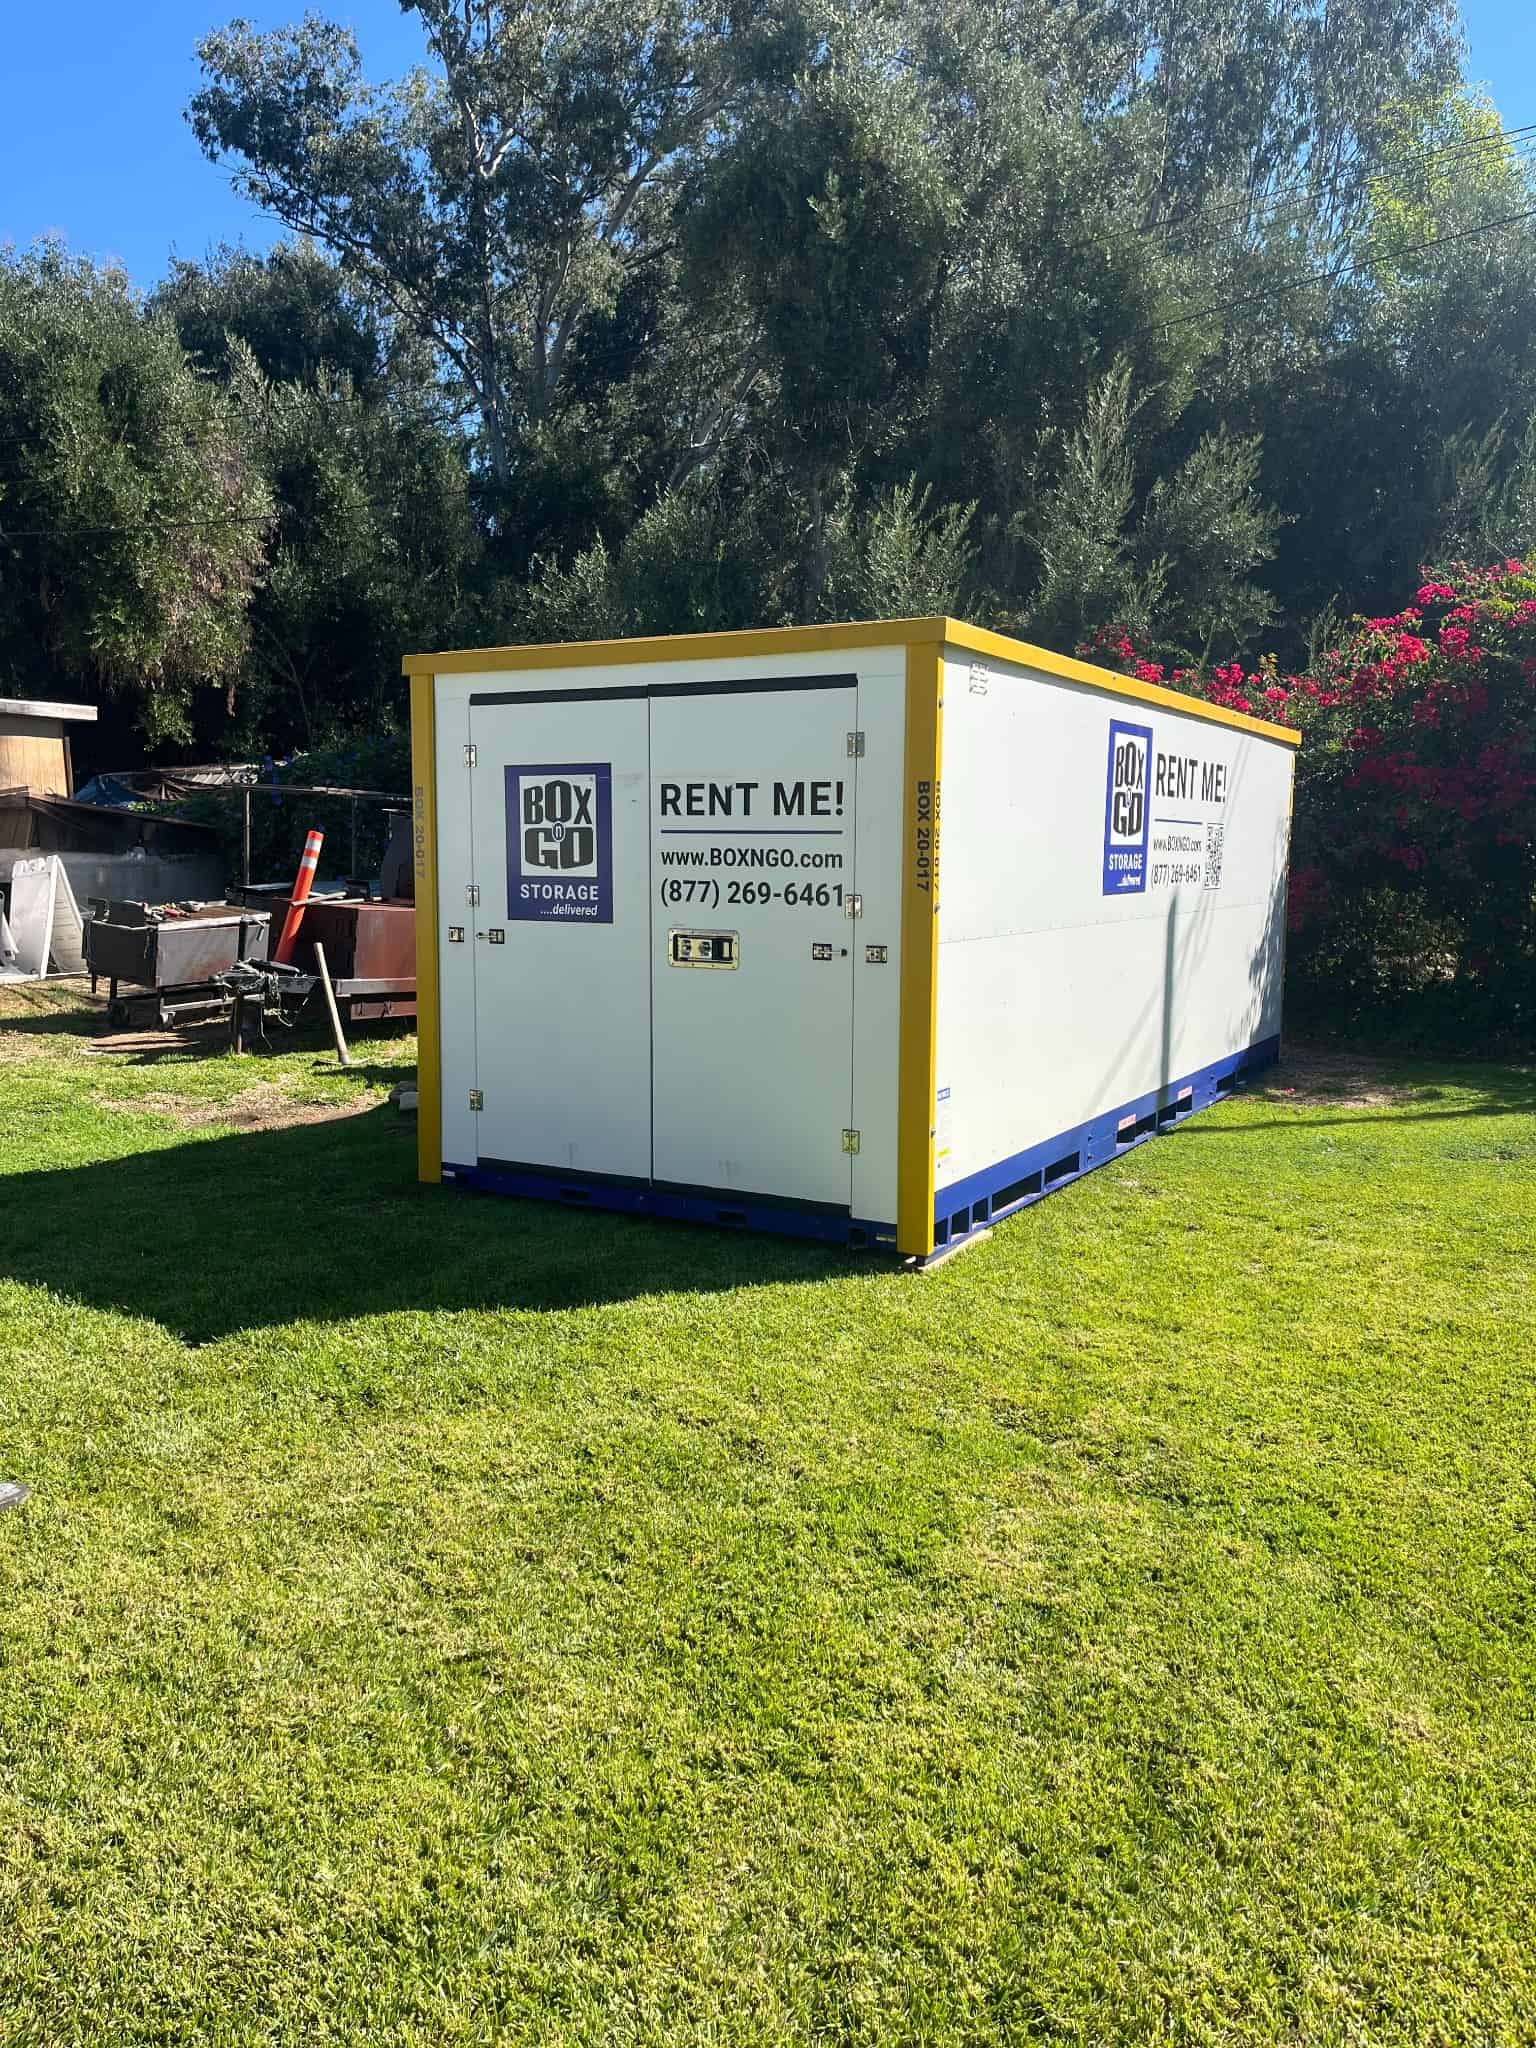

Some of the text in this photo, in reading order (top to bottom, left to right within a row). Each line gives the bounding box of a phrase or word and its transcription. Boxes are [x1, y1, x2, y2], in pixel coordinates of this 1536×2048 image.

[1115, 741, 1144, 789] BOX
[1156, 753, 1198, 800] RENT
[1201, 762, 1227, 804] ME!
[523, 779, 593, 825] BOX
[660, 781, 844, 816] RENT ME!
[1113, 791, 1143, 837] GO
[524, 827, 594, 870] GO
[916, 781, 930, 891] BOX 20-017
[660, 848, 843, 869] www.BOXNGO.com
[1108, 853, 1143, 871] STORAGE
[1151, 864, 1170, 889] (877)
[520, 883, 599, 900] STORAGE
[660, 878, 843, 909] (877) 269-6461
